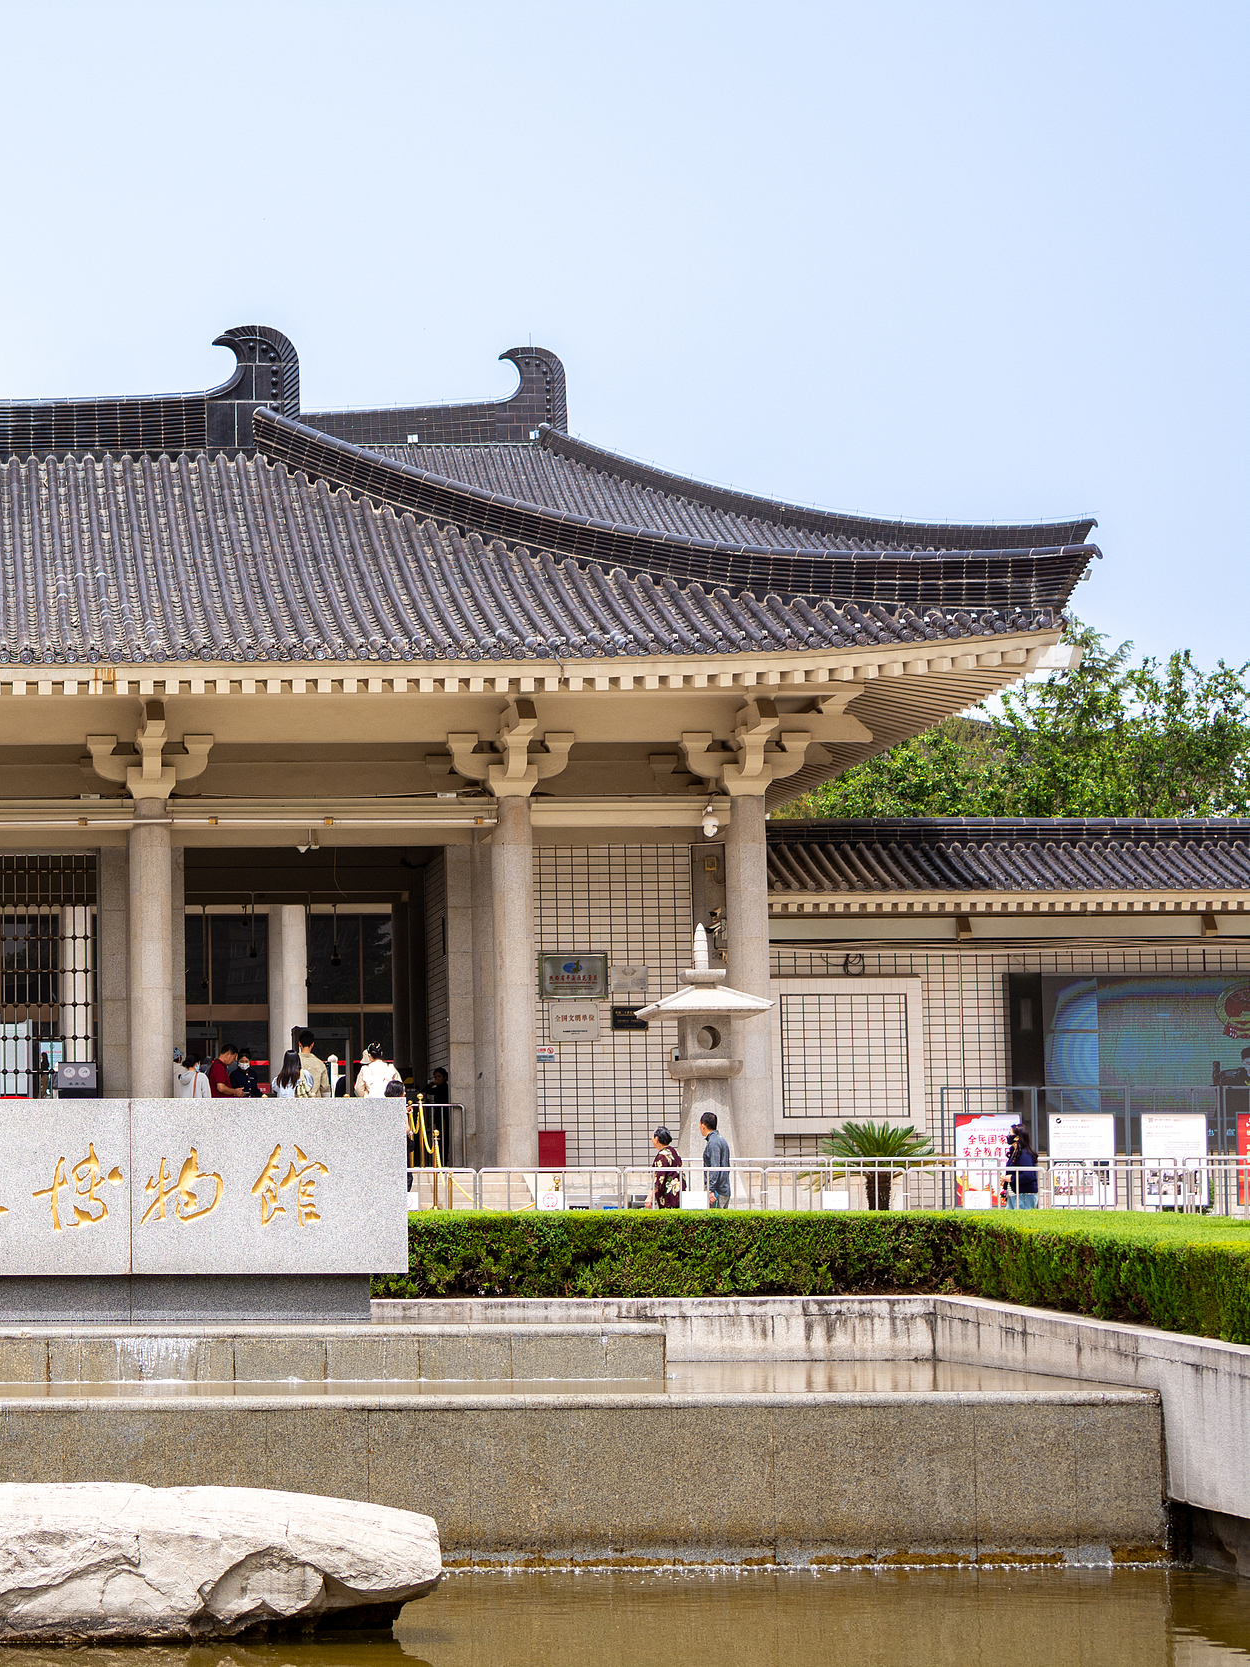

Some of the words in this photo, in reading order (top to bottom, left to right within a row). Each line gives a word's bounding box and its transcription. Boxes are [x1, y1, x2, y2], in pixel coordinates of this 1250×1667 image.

[555, 1014, 595, 1022] 全国文明单位
[968, 1134, 1007, 1145] 全民国家
